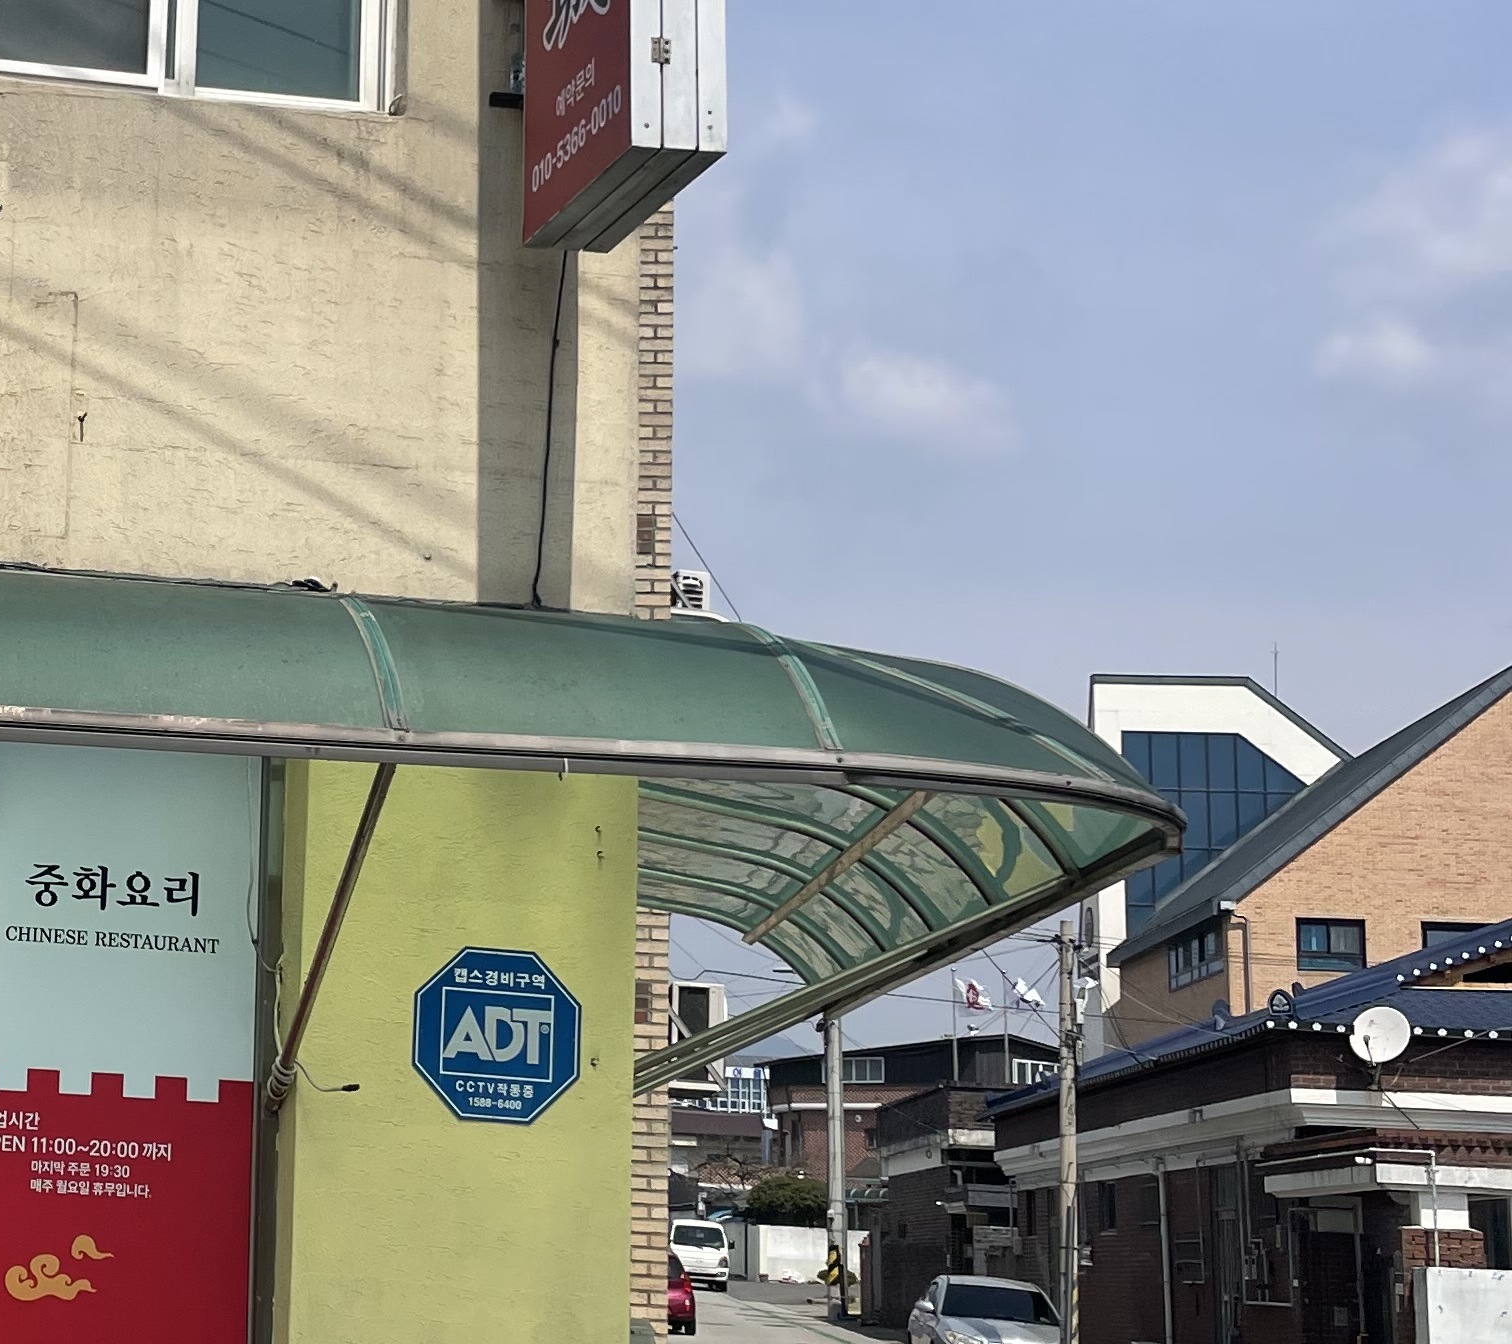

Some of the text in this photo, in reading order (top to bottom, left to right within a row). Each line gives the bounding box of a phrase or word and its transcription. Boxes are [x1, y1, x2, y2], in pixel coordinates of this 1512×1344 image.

[555, 56, 595, 117] 예약문의
[532, 84, 622, 193] 010-5366-0010
[24, 862, 201, 917] 중화요리
[4, 925, 220, 955] CHINESE RESTAURANT
[453, 967, 545, 989] 캡스경비구역
[442, 1005, 552, 1065] ADT
[455, 1079, 535, 1099] CCTV작동중
[467, 1096, 523, 1110] 1588-6400
[31, 1136, 139, 1159] 11:00~20:00
[141, 1141, 172, 1162] 까지
[30, 1159, 131, 1179] 마지막 주문 19:30
[29, 1178, 153, 1199] 매주 월요일 휴무입니다.
